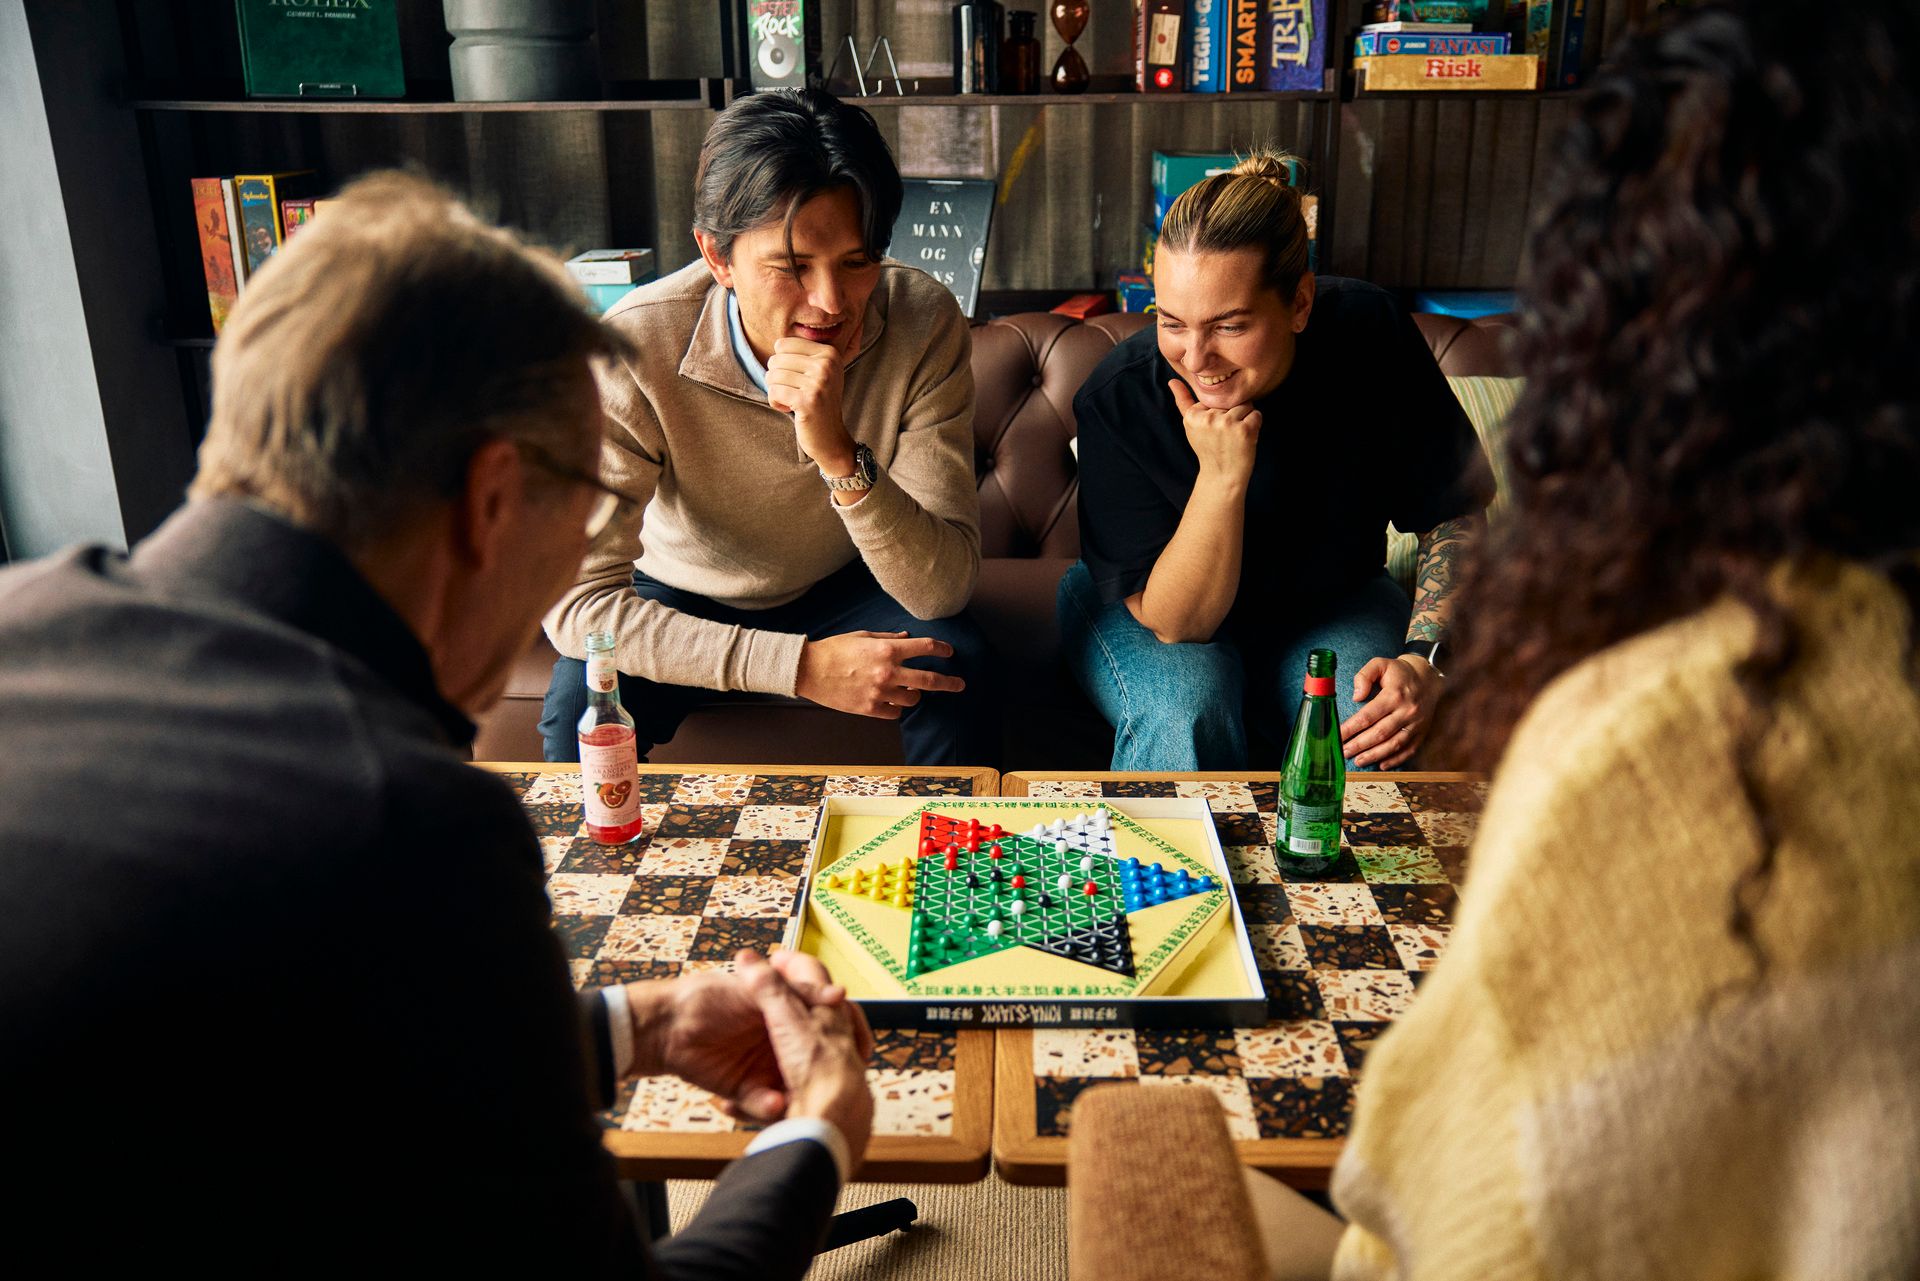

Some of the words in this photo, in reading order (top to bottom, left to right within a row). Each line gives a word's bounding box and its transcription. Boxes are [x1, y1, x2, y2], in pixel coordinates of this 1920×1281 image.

[1236, 0, 1257, 84] SMART
[1428, 38, 1496, 55] FANTASI
[1192, 26, 1211, 86] TEGN
[1425, 58, 1482, 77] Risk
[929, 201, 953, 215] EN
[912, 223, 964, 238] MANN
[920, 247, 946, 260] OG
